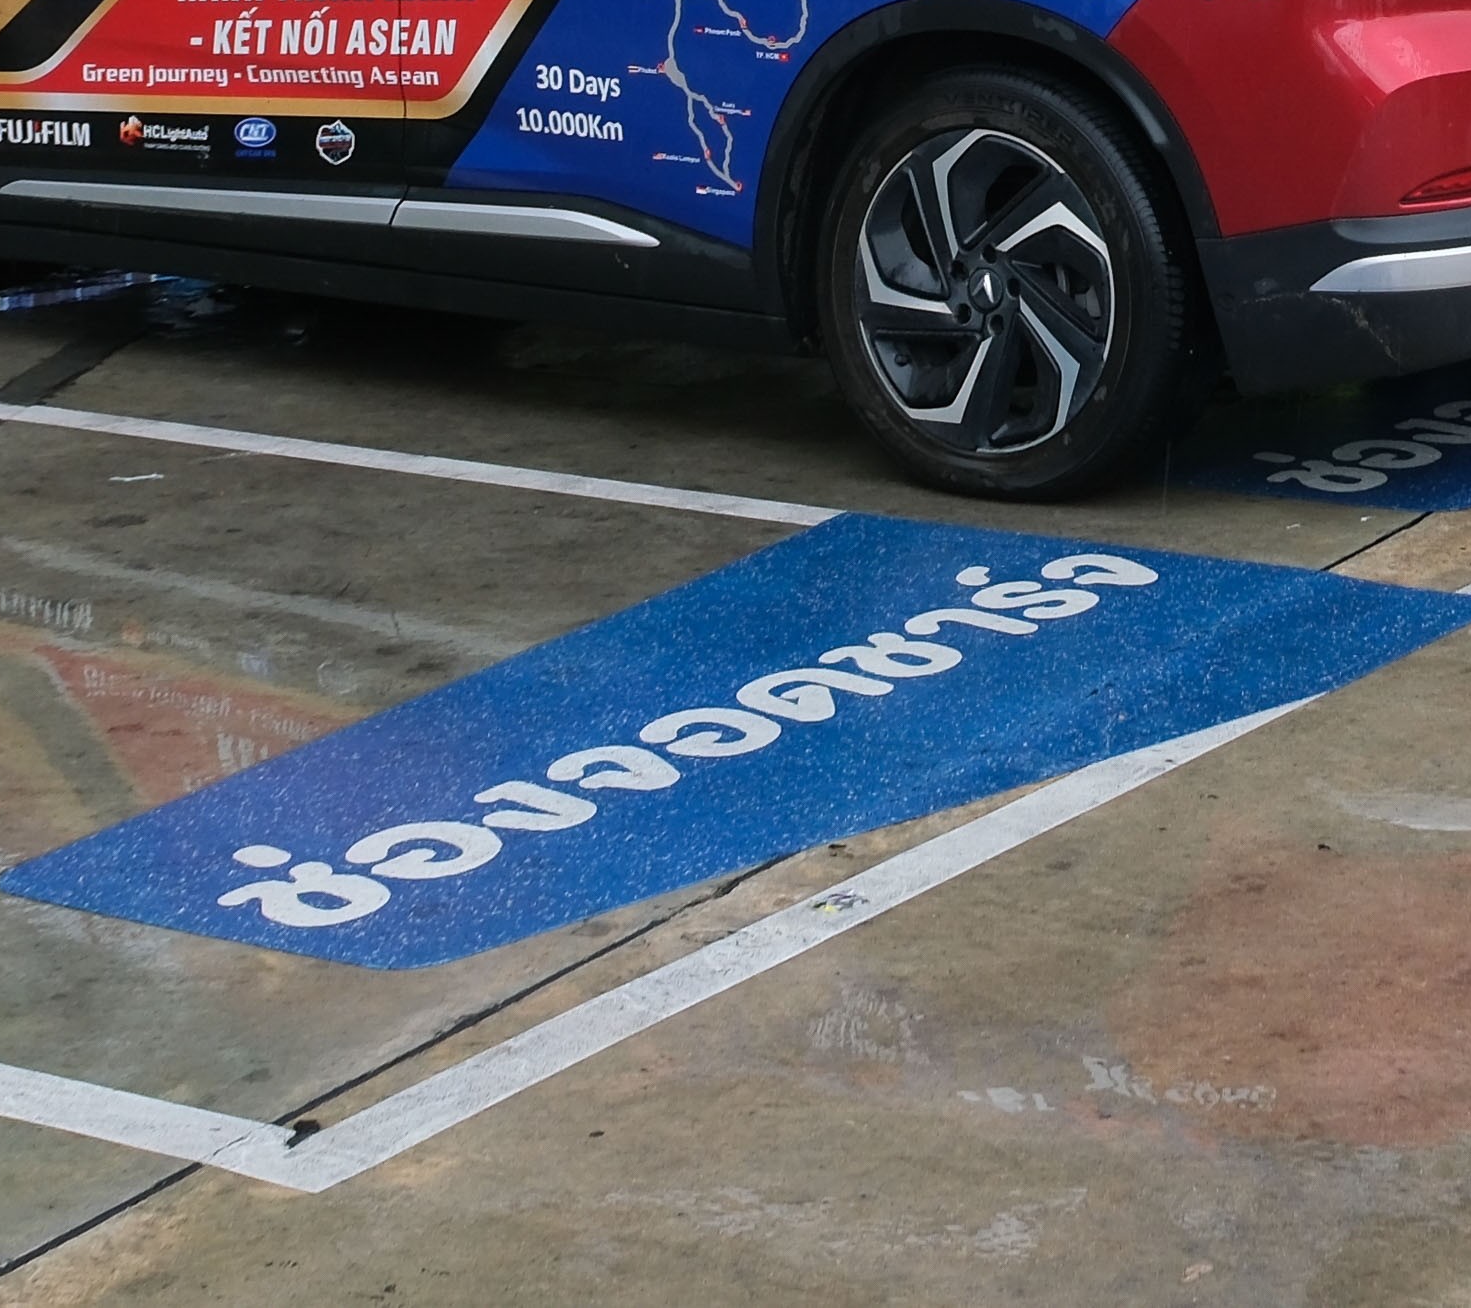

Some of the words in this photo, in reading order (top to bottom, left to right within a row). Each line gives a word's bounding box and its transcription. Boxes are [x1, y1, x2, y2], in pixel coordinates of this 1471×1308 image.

[213, 6, 273, 56] KẾT
[280, 5, 338, 55] NỐI
[345, 18, 457, 55] ASEAN
[82, 62, 144, 83] Green
[146, 63, 228, 88] Journey
[246, 62, 364, 88] Connecting
[370, 65, 440, 86] Asean
[535, 65, 562, 90] 30
[569, 68, 621, 101] Days
[517, 107, 624, 142] 10.000Km
[218, 554, 1160, 928] ช่องจอดชาร์จ
